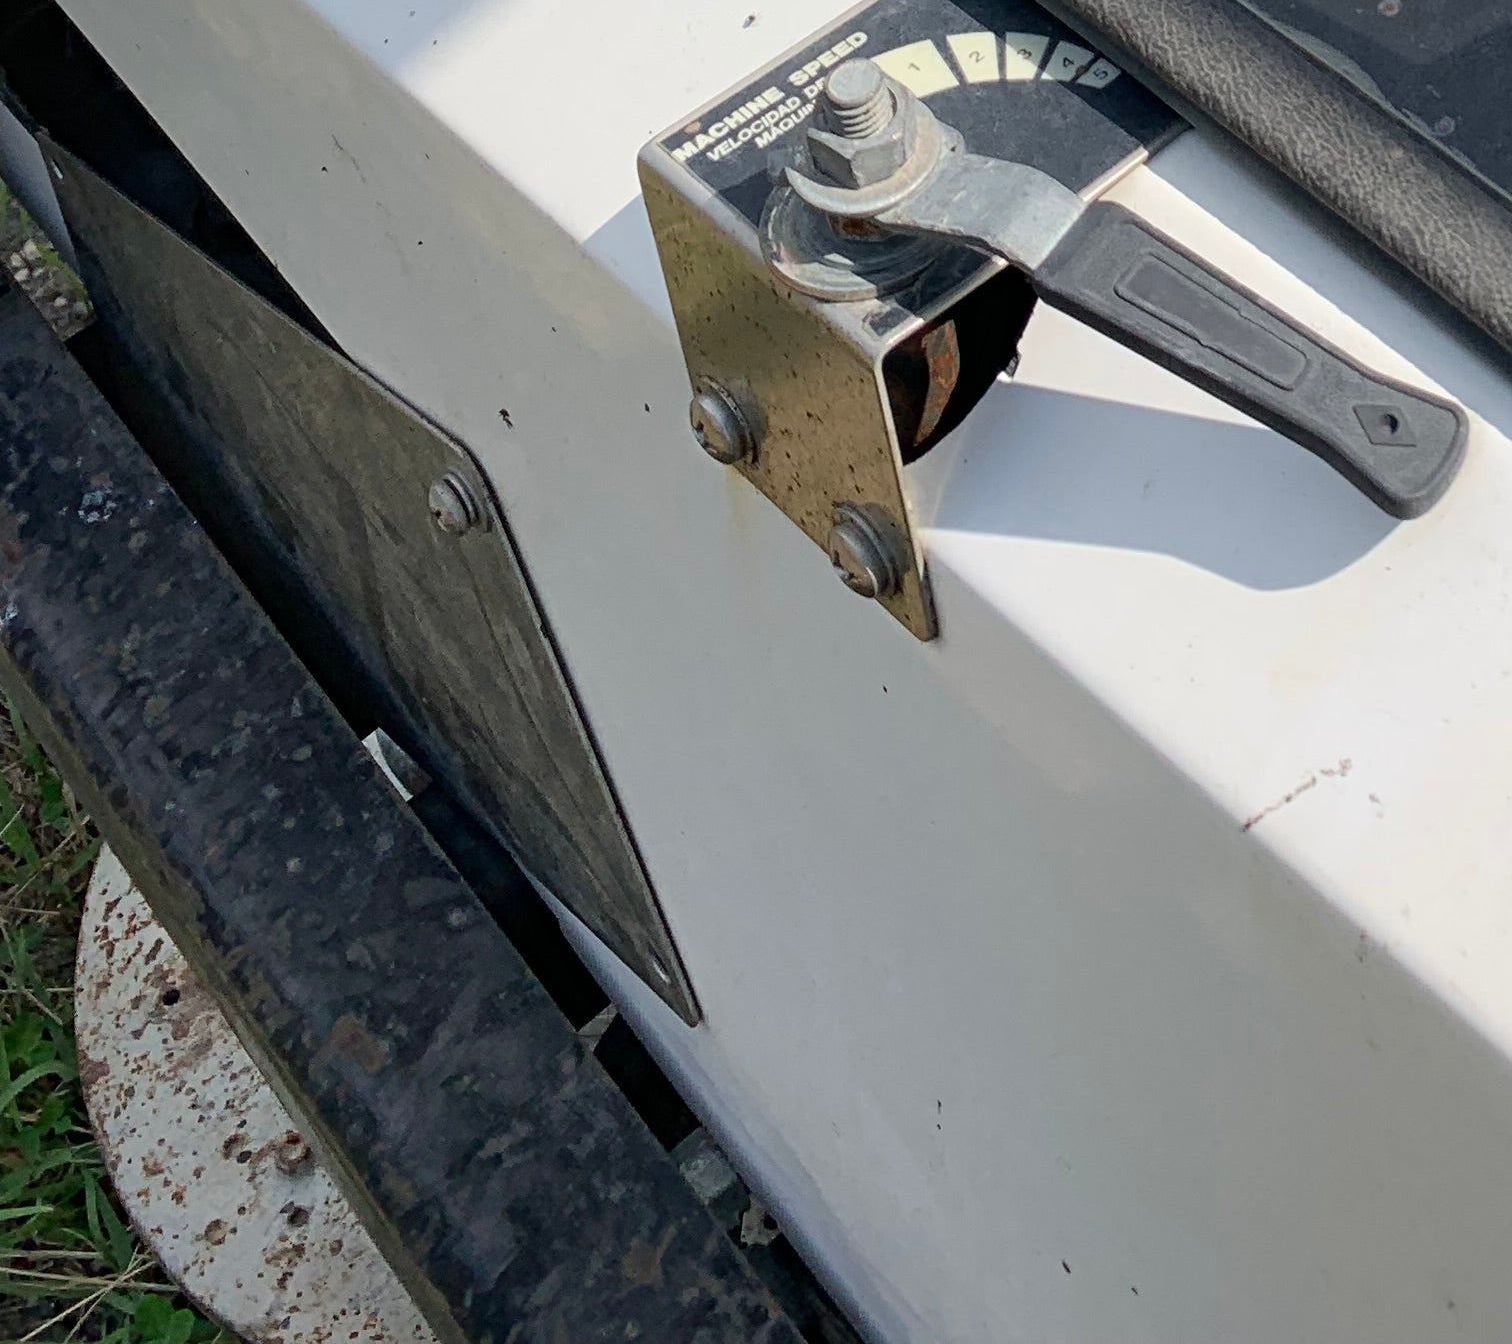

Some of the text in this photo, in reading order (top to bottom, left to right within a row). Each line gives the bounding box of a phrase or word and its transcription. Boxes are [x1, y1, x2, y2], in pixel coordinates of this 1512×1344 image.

[968, 50, 986, 64] 2
[1016, 47, 1033, 61] 3
[907, 62, 922, 73] 1
[1062, 56, 1075, 70] 4
[1093, 67, 1109, 81] 5
[670, 31, 868, 162] MACHINE SPEED
[706, 96, 801, 162] VELOCIDAD
